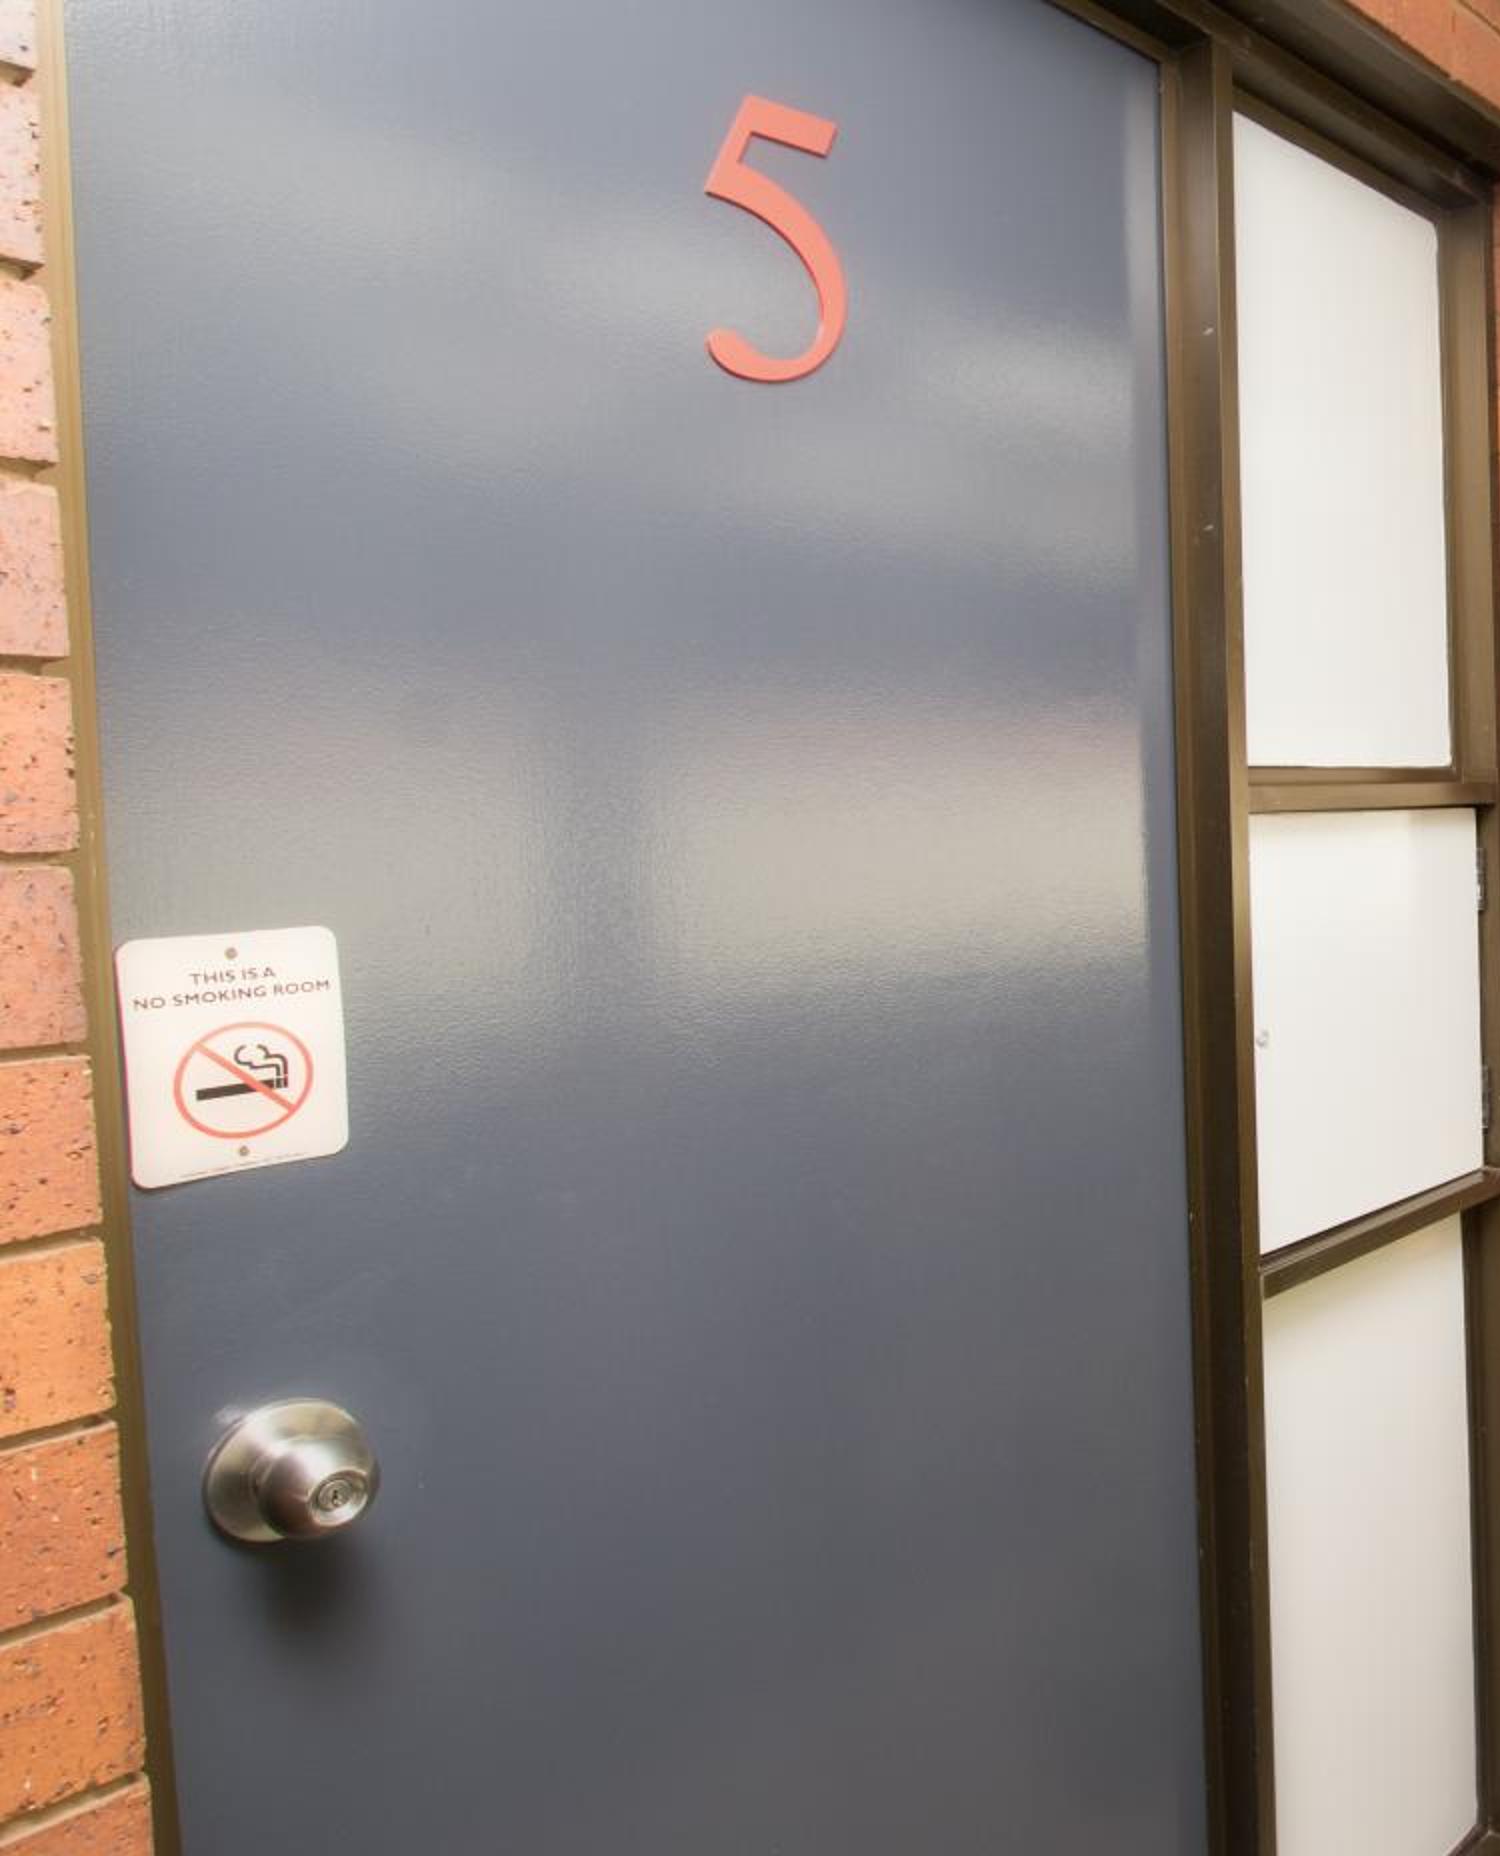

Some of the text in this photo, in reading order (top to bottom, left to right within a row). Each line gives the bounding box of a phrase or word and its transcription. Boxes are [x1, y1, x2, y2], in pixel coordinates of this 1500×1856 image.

[704, 95, 848, 382] 5
[189, 966, 276, 986] THIS IS A
[133, 979, 331, 1011] NO SMOKING ROOM
